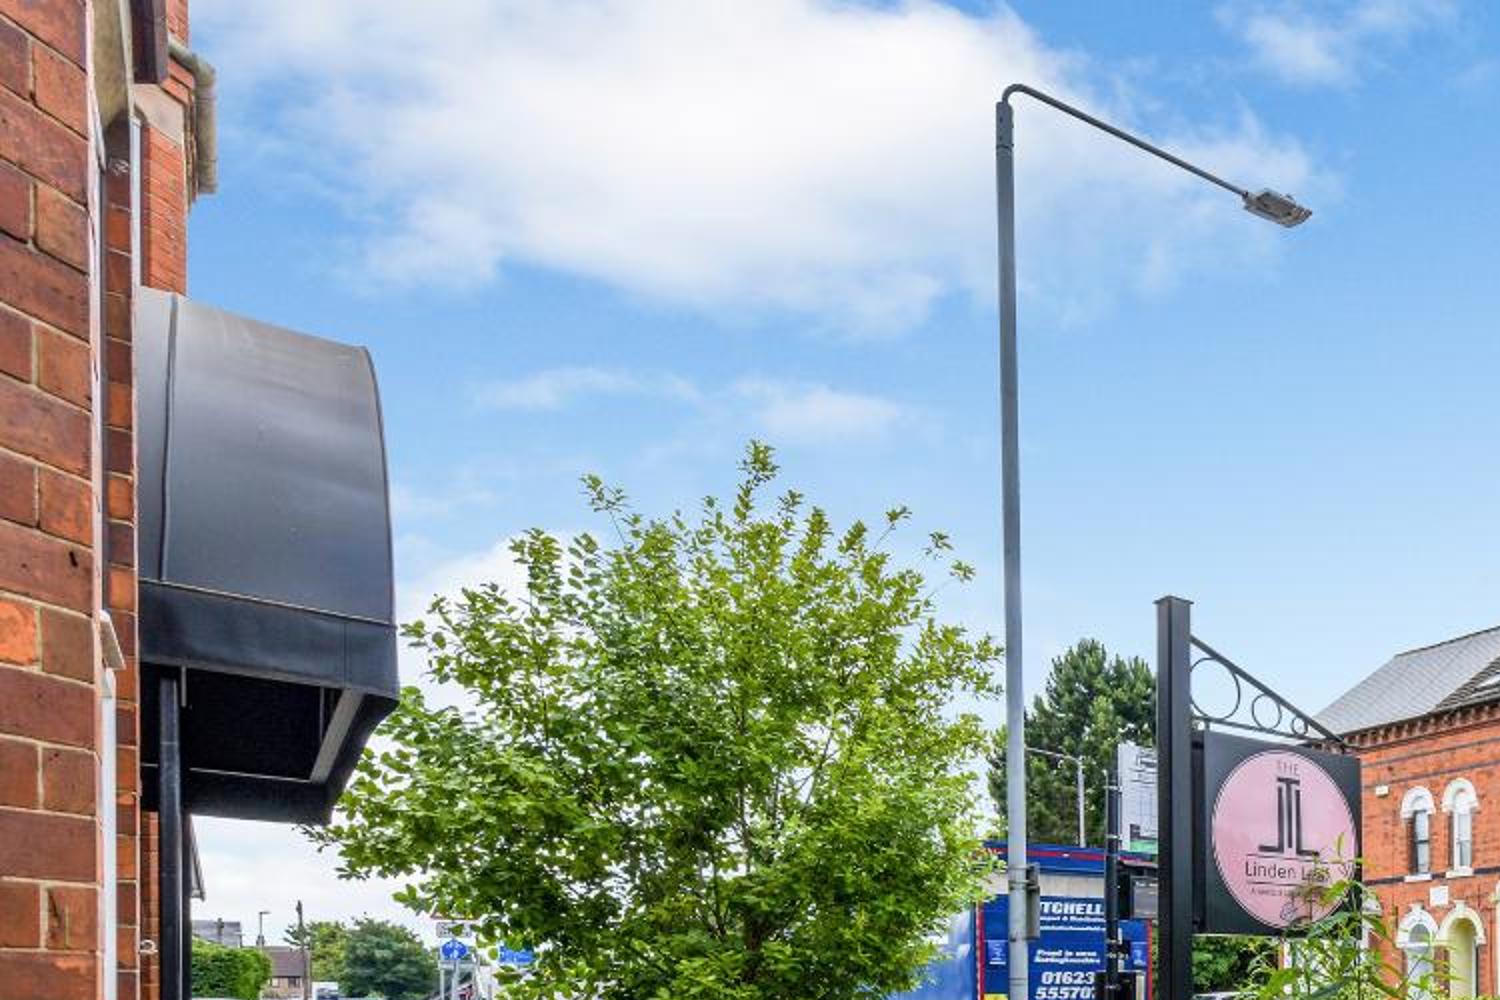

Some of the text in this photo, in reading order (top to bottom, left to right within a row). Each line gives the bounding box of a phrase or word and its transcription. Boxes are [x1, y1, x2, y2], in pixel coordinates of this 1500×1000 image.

[1245, 861, 1297, 879] Linden
[1040, 901, 1104, 915] TCHELL
[1041, 971, 1096, 985] 01623
